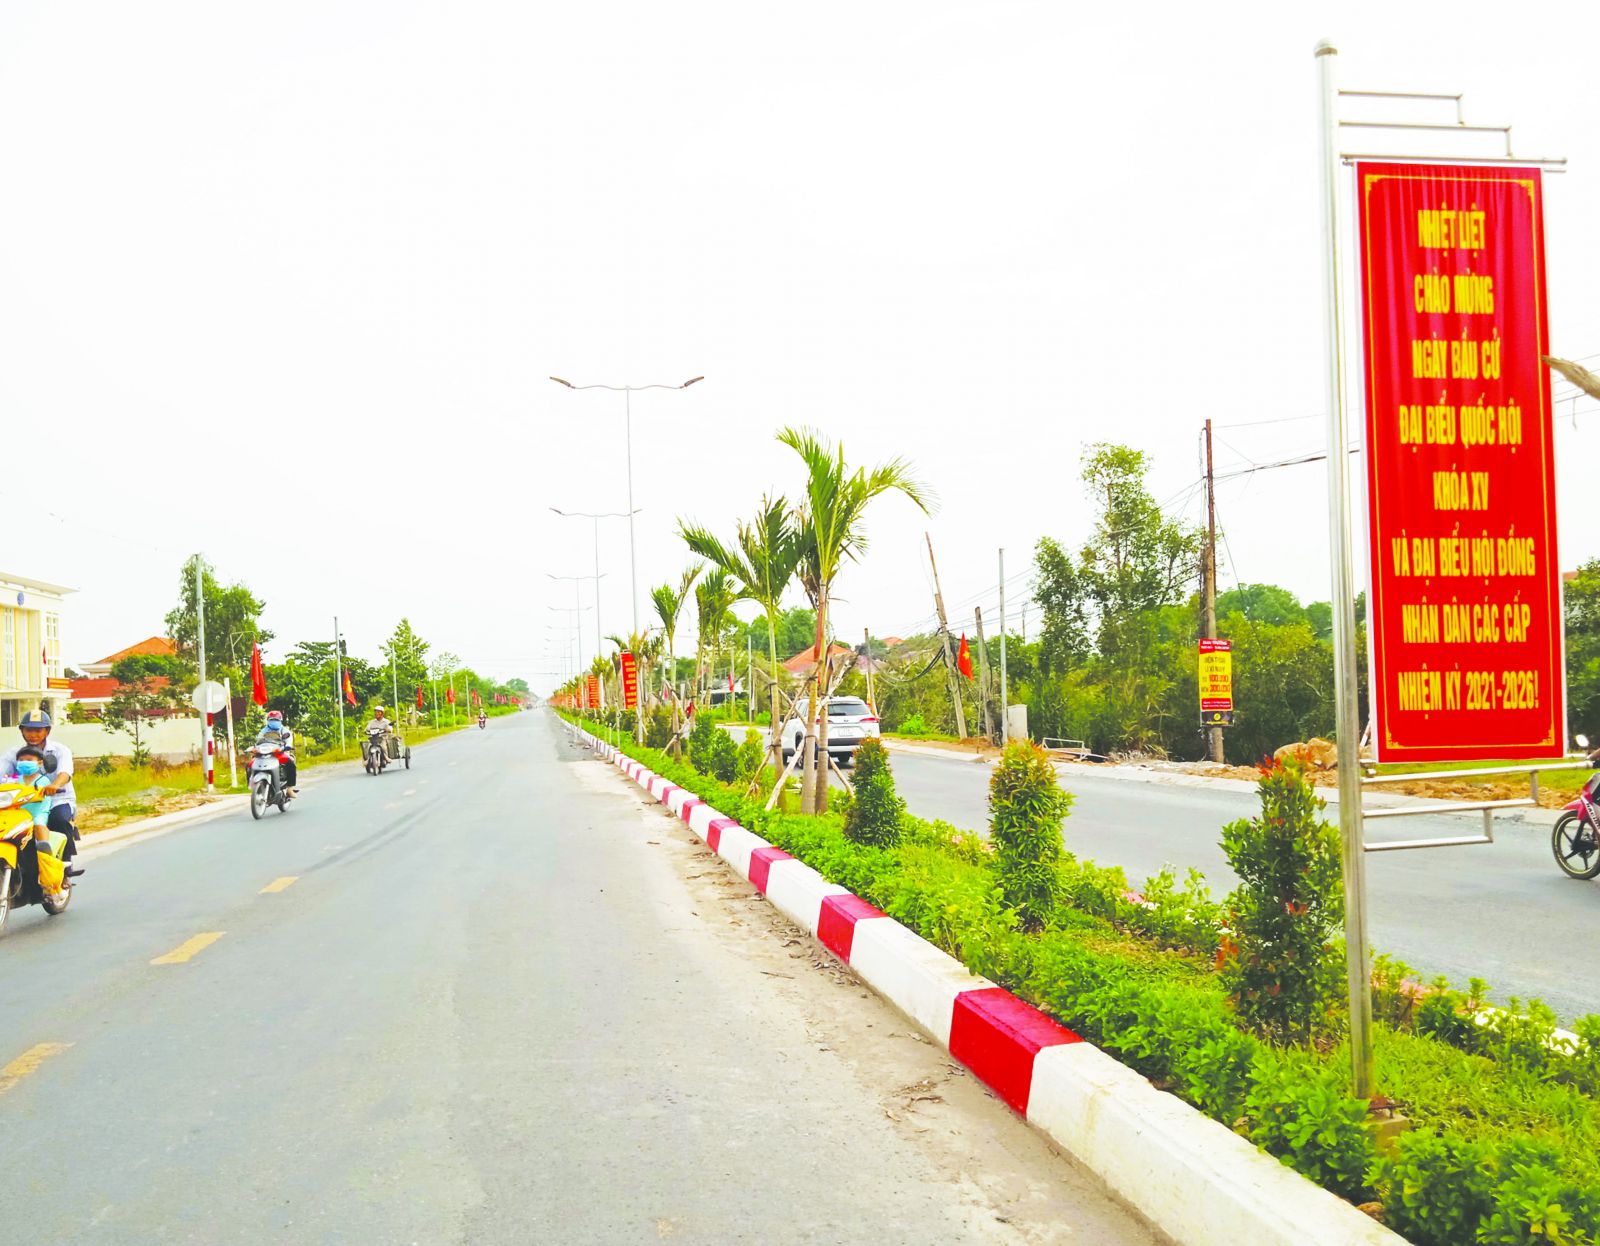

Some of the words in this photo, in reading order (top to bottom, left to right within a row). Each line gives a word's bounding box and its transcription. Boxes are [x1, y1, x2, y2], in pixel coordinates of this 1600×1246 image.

[1418, 202, 1456, 257] NHIỆT
[1458, 203, 1485, 257] LIỆT
[1414, 267, 1450, 313] CHÀO
[1412, 332, 1447, 379] NGÀY
[1482, 328, 1500, 379] CỬ
[1399, 405, 1422, 452] ĐẠI
[1426, 390, 1456, 444] BIỂU
[1460, 393, 1495, 448] QUỐC
[1498, 398, 1521, 453] HỘI
[1433, 464, 1469, 510] KHÓA
[1471, 472, 1488, 510] XV
[1392, 529, 1410, 576] VÀ
[1413, 538, 1435, 585] ĐẠI
[1440, 522, 1469, 576] BIỂU
[1472, 530, 1494, 585] HỘI
[1402, 596, 1439, 643] NHÂN
[1443, 597, 1470, 643] DÂN
[1474, 596, 1499, 643] CÁC
[1398, 663, 1442, 719] NHIỆM
[1446, 664, 1460, 710] KỲ
[1466, 671, 1538, 710] 2021-2026!
